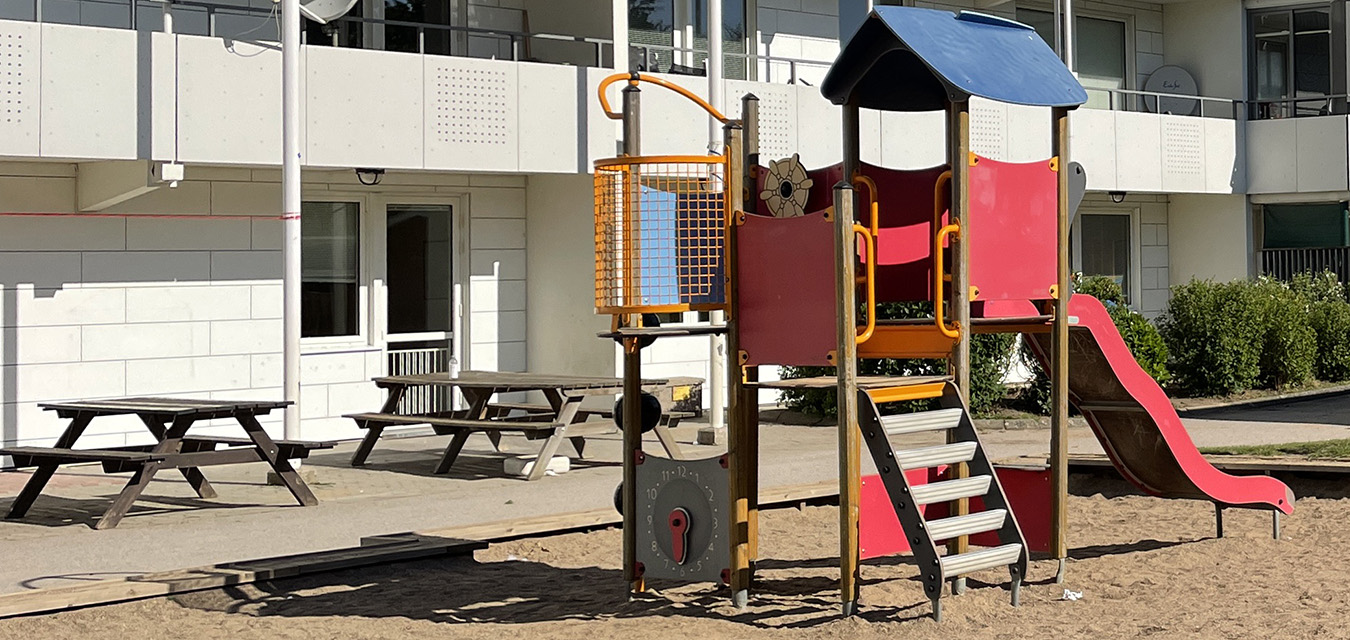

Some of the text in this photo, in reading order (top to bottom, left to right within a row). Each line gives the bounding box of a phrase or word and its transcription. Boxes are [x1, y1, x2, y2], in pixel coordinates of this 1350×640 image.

[661, 470, 670, 481] 11
[677, 465, 687, 478] 12
[646, 488, 657, 500] 10
[708, 489, 714, 502] 2
[647, 515, 653, 525] 9
[713, 517, 718, 529] 3
[651, 540, 657, 552] 8
[708, 542, 714, 551] 4
[663, 559, 669, 569] 7
[697, 560, 702, 572] 5
